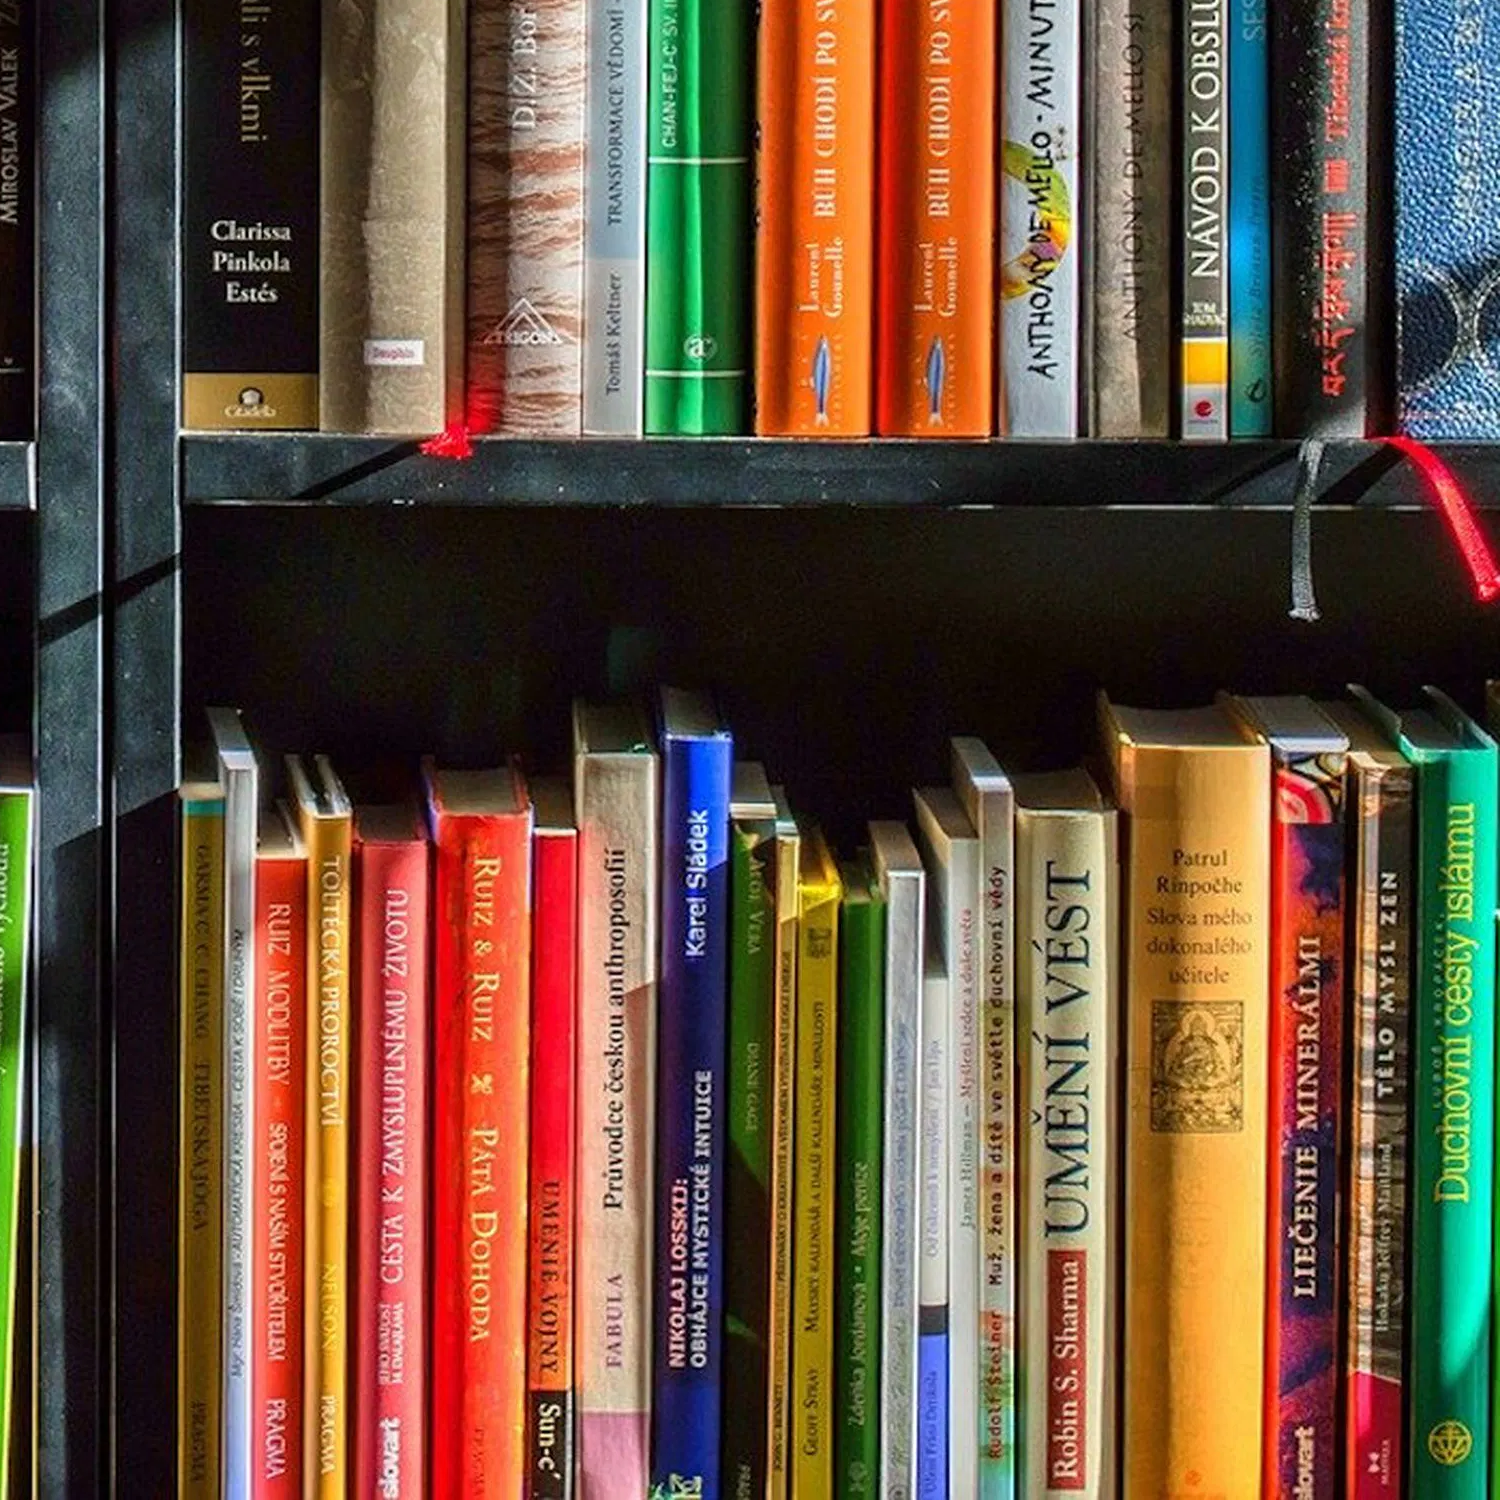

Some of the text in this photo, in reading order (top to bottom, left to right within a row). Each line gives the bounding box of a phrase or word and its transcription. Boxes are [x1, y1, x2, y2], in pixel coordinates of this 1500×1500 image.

[605, 10, 625, 81] VĚDOMÍ
[814, 32, 838, 64] PO
[239, 60, 271, 142] vlkmi
[1191, 111, 1219, 133] K
[607, 87, 625, 226] TRANSFORMACE
[812, 167, 837, 217] BŮH
[211, 221, 291, 241] Clarissa
[1184, 146, 1220, 278] NÁVOD
[212, 252, 290, 272] Pinkola
[226, 281, 277, 304] Estés
[801, 242, 820, 313] Laurent
[826, 236, 846, 317] Gounelle
[606, 274, 622, 337] Keltner
[604, 344, 622, 396] Tomáš
[684, 810, 710, 956] Karel Sládek
[1433, 804, 1478, 1202] Duchovní cesty islámu
[379, 890, 408, 1284] CESTA K ZMYSLUPLNÉMU ŽIVOTU
[601, 849, 630, 1369] FABULA Průvodce českou anthroposofií
[1287, 936, 1321, 1297] LIEČENIE MINERÁLMI
[1031, 861, 1091, 1479] Robin S. Sharma UMĚNÍ VÉST
[688, 1071, 713, 1368] OBHÁJCE MYSTICKÉ INTUICE
[669, 1179, 689, 1368] NIKOLAJ LOSSKIJ:
